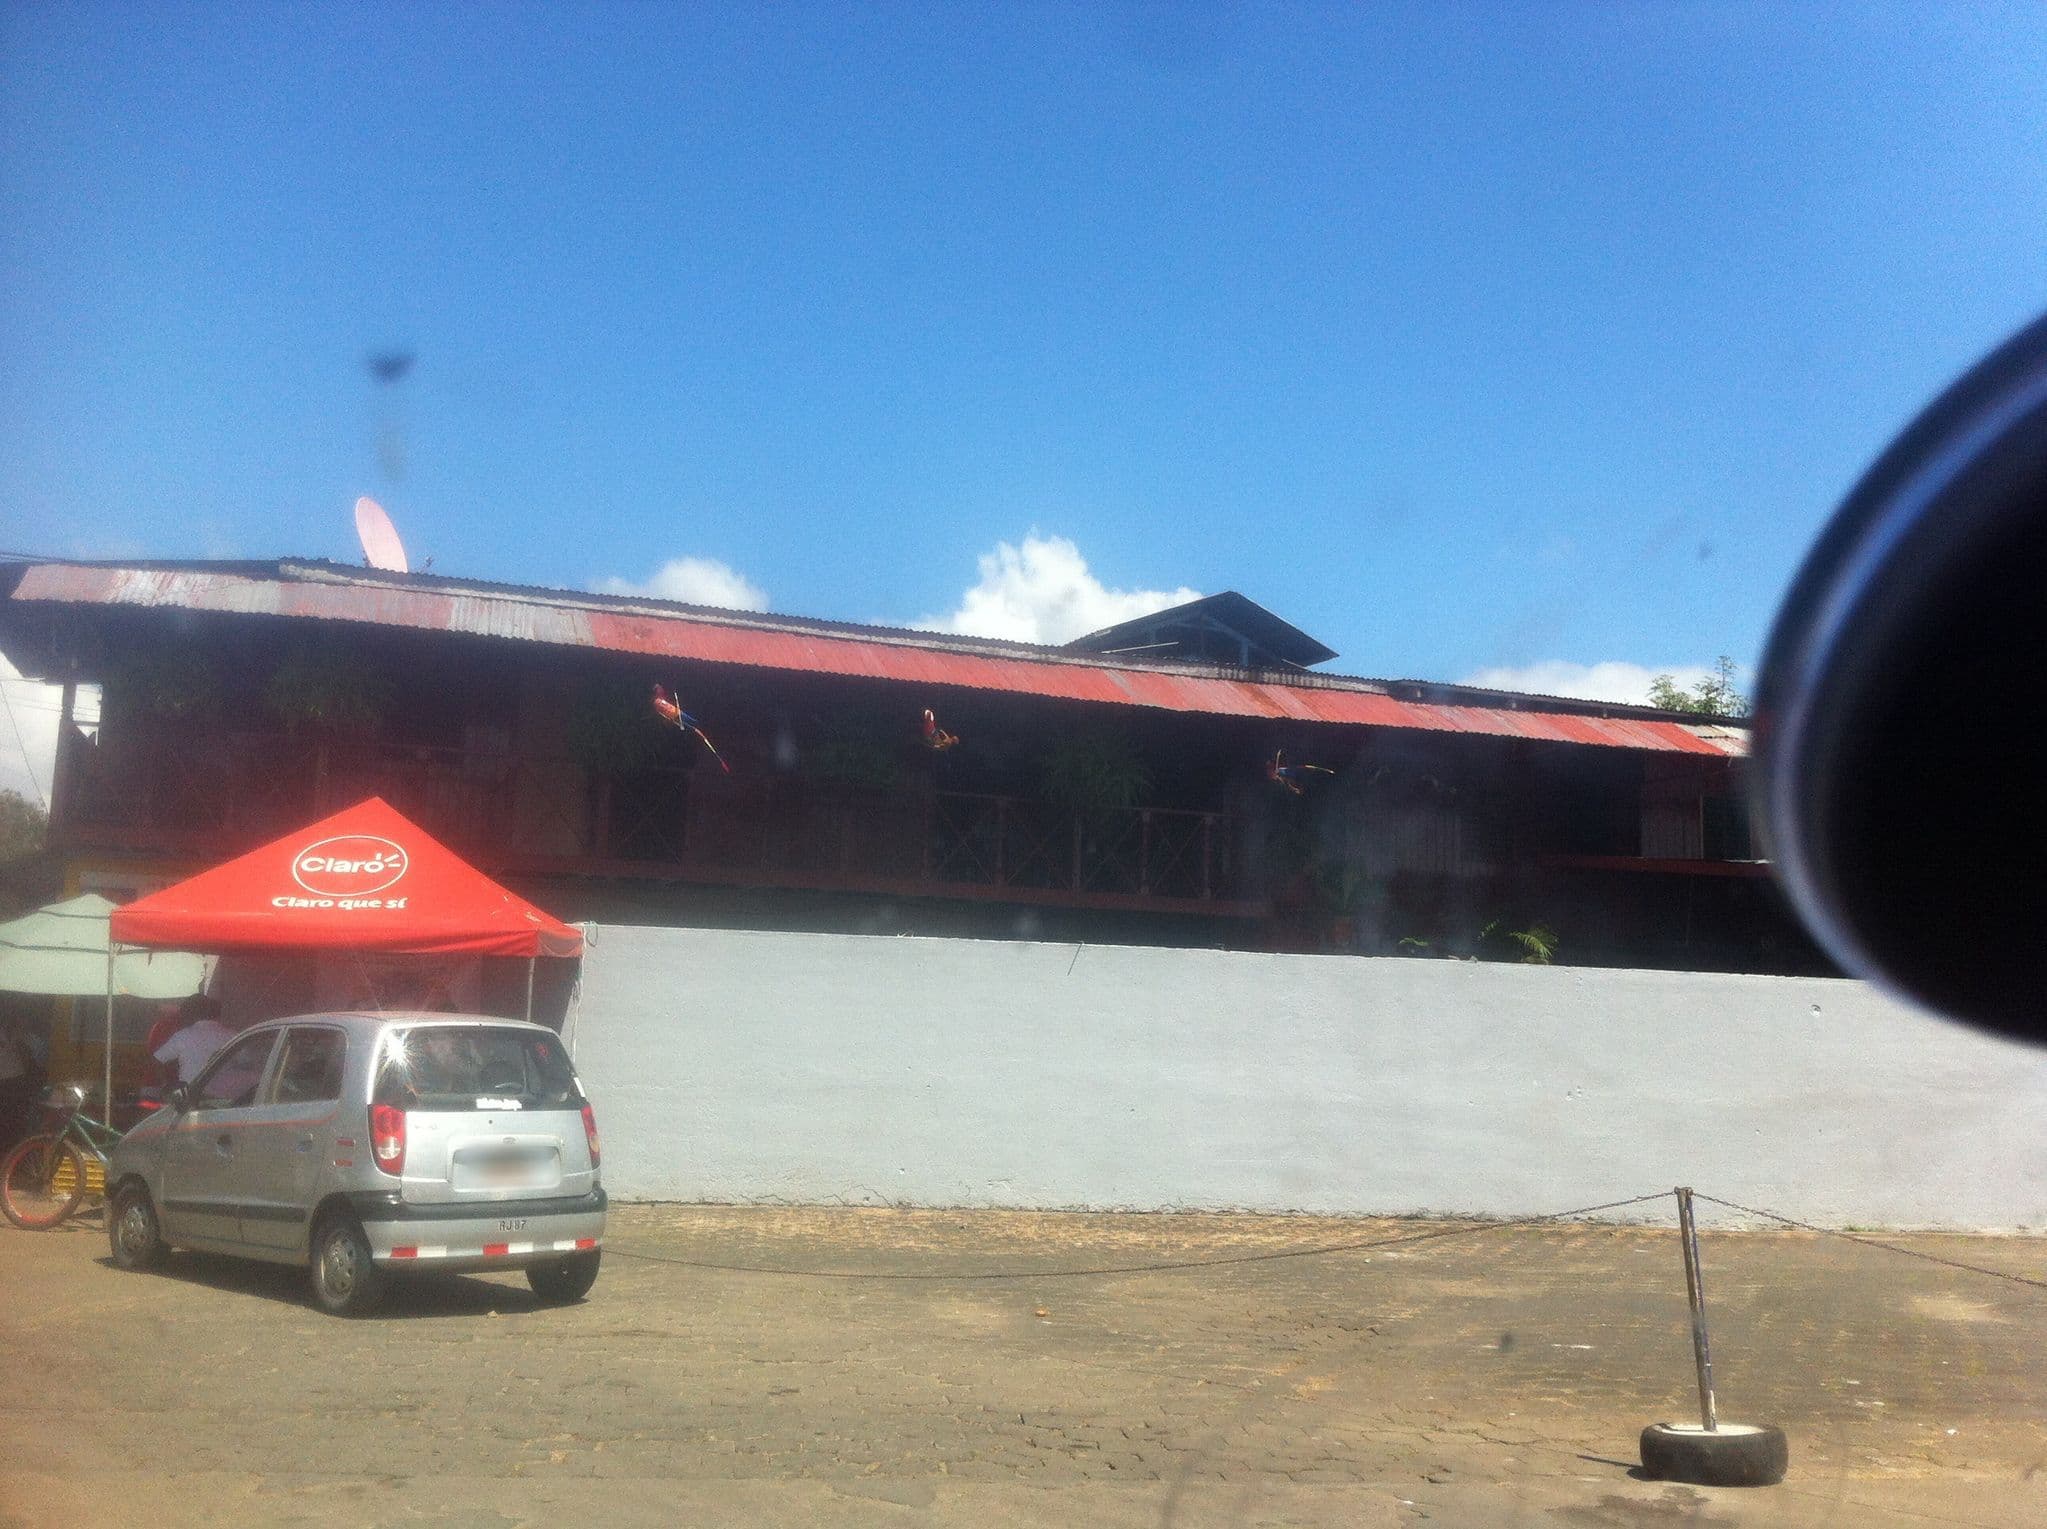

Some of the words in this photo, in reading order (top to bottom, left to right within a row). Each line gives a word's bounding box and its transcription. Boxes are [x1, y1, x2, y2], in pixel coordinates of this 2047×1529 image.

[301, 853, 386, 874] Claro
[272, 896, 334, 909] Claro
[337, 898, 383, 911] que
